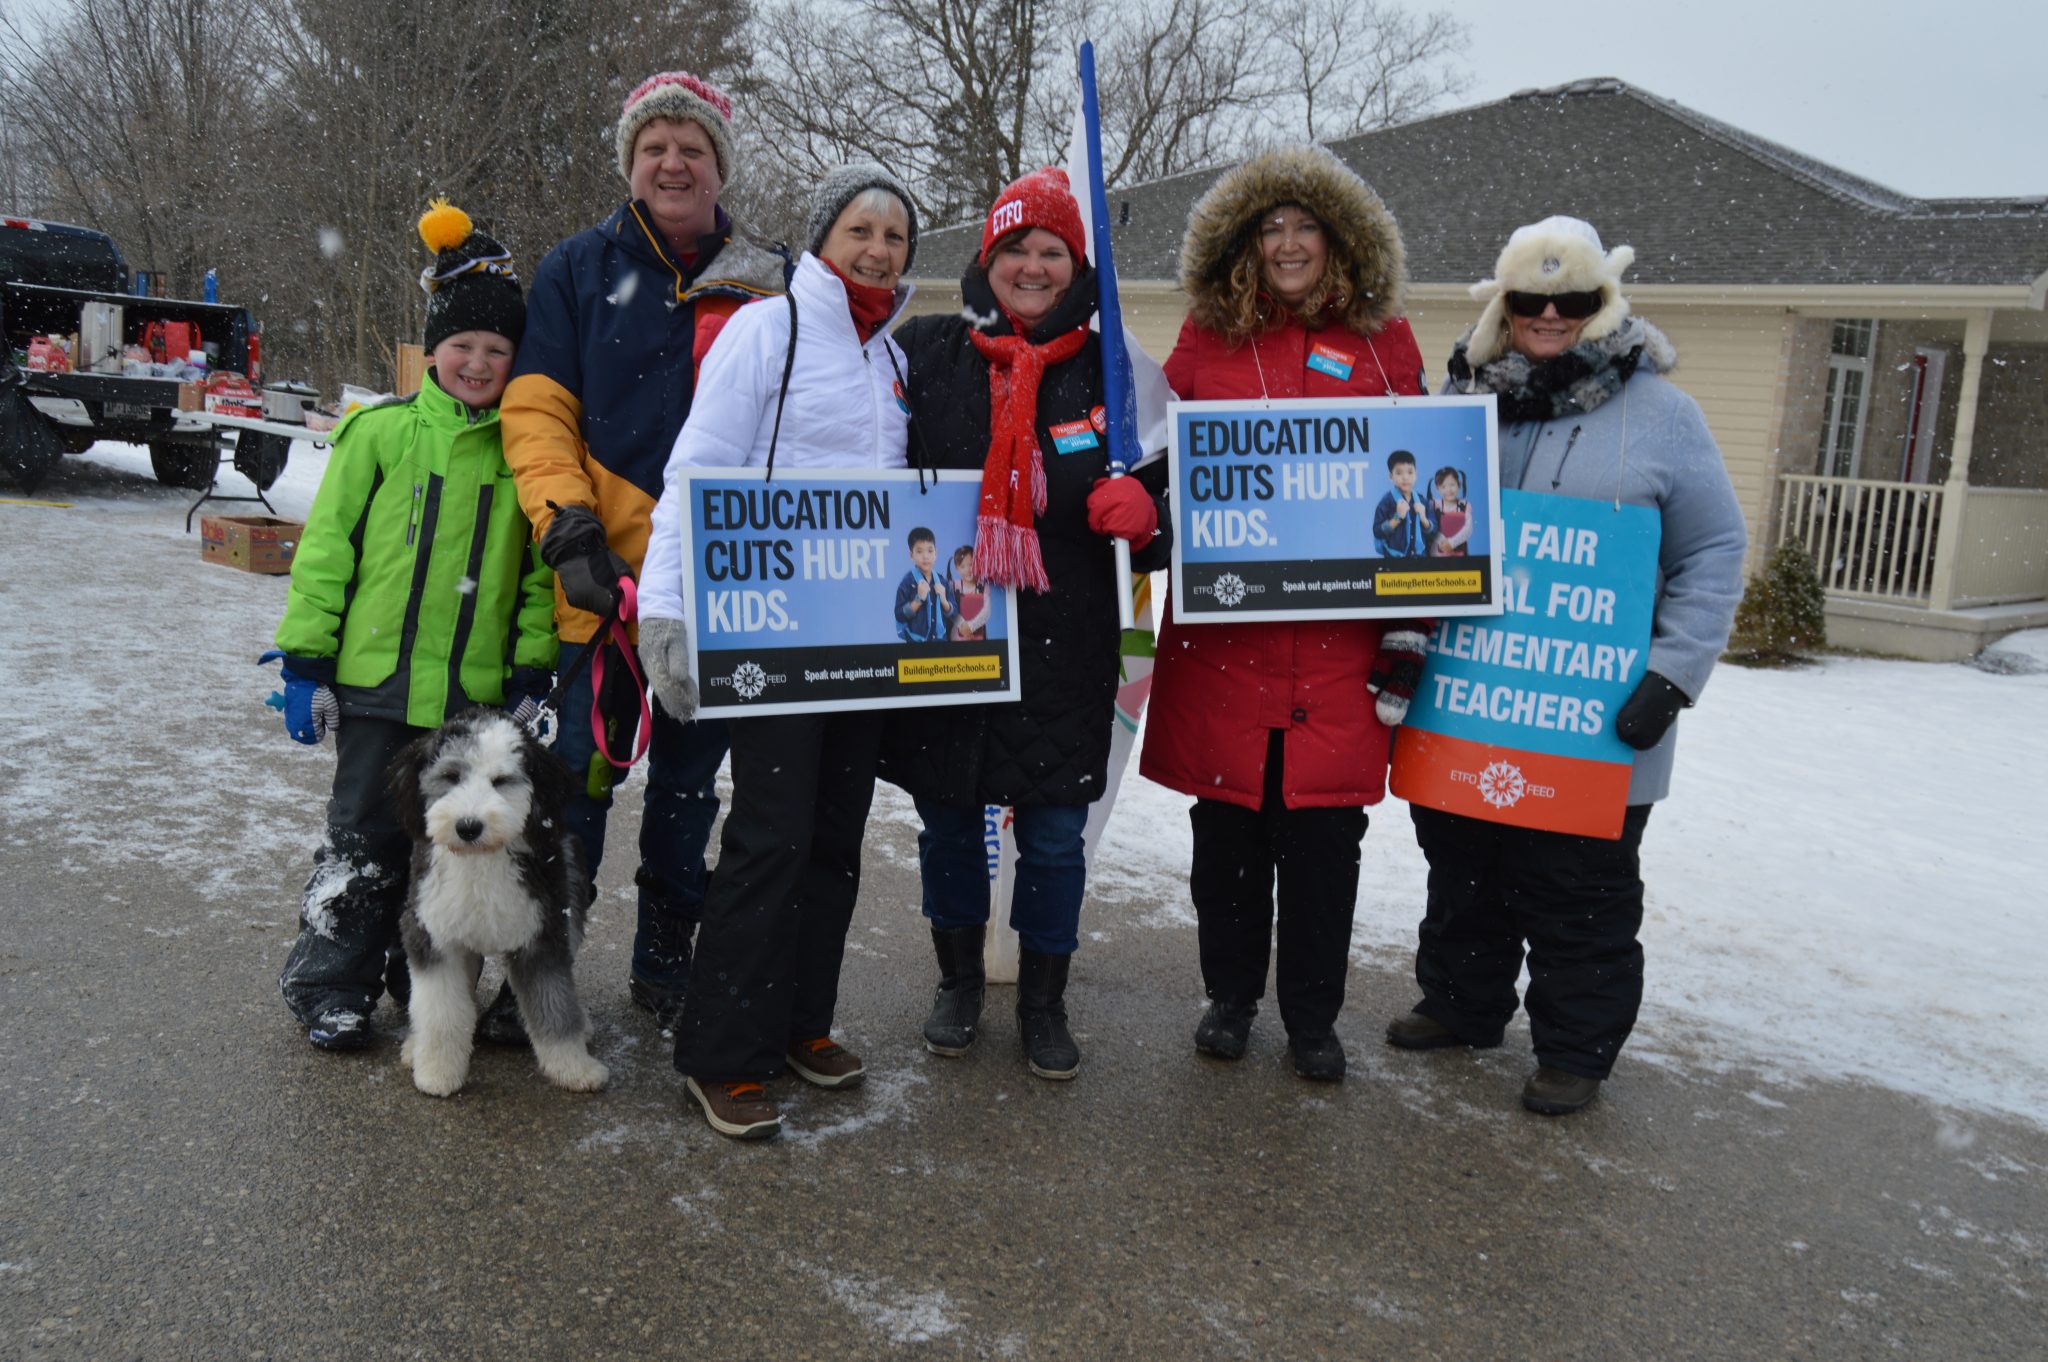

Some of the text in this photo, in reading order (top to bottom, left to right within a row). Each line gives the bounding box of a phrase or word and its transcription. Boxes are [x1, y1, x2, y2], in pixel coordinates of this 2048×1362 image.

[992, 198, 1023, 236] ETFO
[1188, 416, 1370, 457] EDUCATION
[1189, 461, 1369, 502] CUTS HURT
[702, 489, 890, 531] EDUCATION
[1191, 508, 1278, 549] KIDS.
[704, 538, 890, 582] CUTS HURT
[1517, 522, 1599, 567] FAIR
[1193, 585, 1213, 595] ETFO
[1282, 578, 1372, 593] Speak out against cuts!
[1380, 577, 1477, 590] BuildingBetterSchools.ca
[1502, 576, 1617, 625] AL FOR
[707, 589, 799, 633] KIDS.
[903, 663, 996, 677] BuildingBetterSchools.ca
[1425, 621, 1639, 684] ELEMENTARY
[710, 676, 732, 687] ETFO
[804, 666, 895, 683] Speak out against cuts!
[1433, 673, 1606, 736] TEACHERS
[1450, 769, 1477, 785] ETFO
